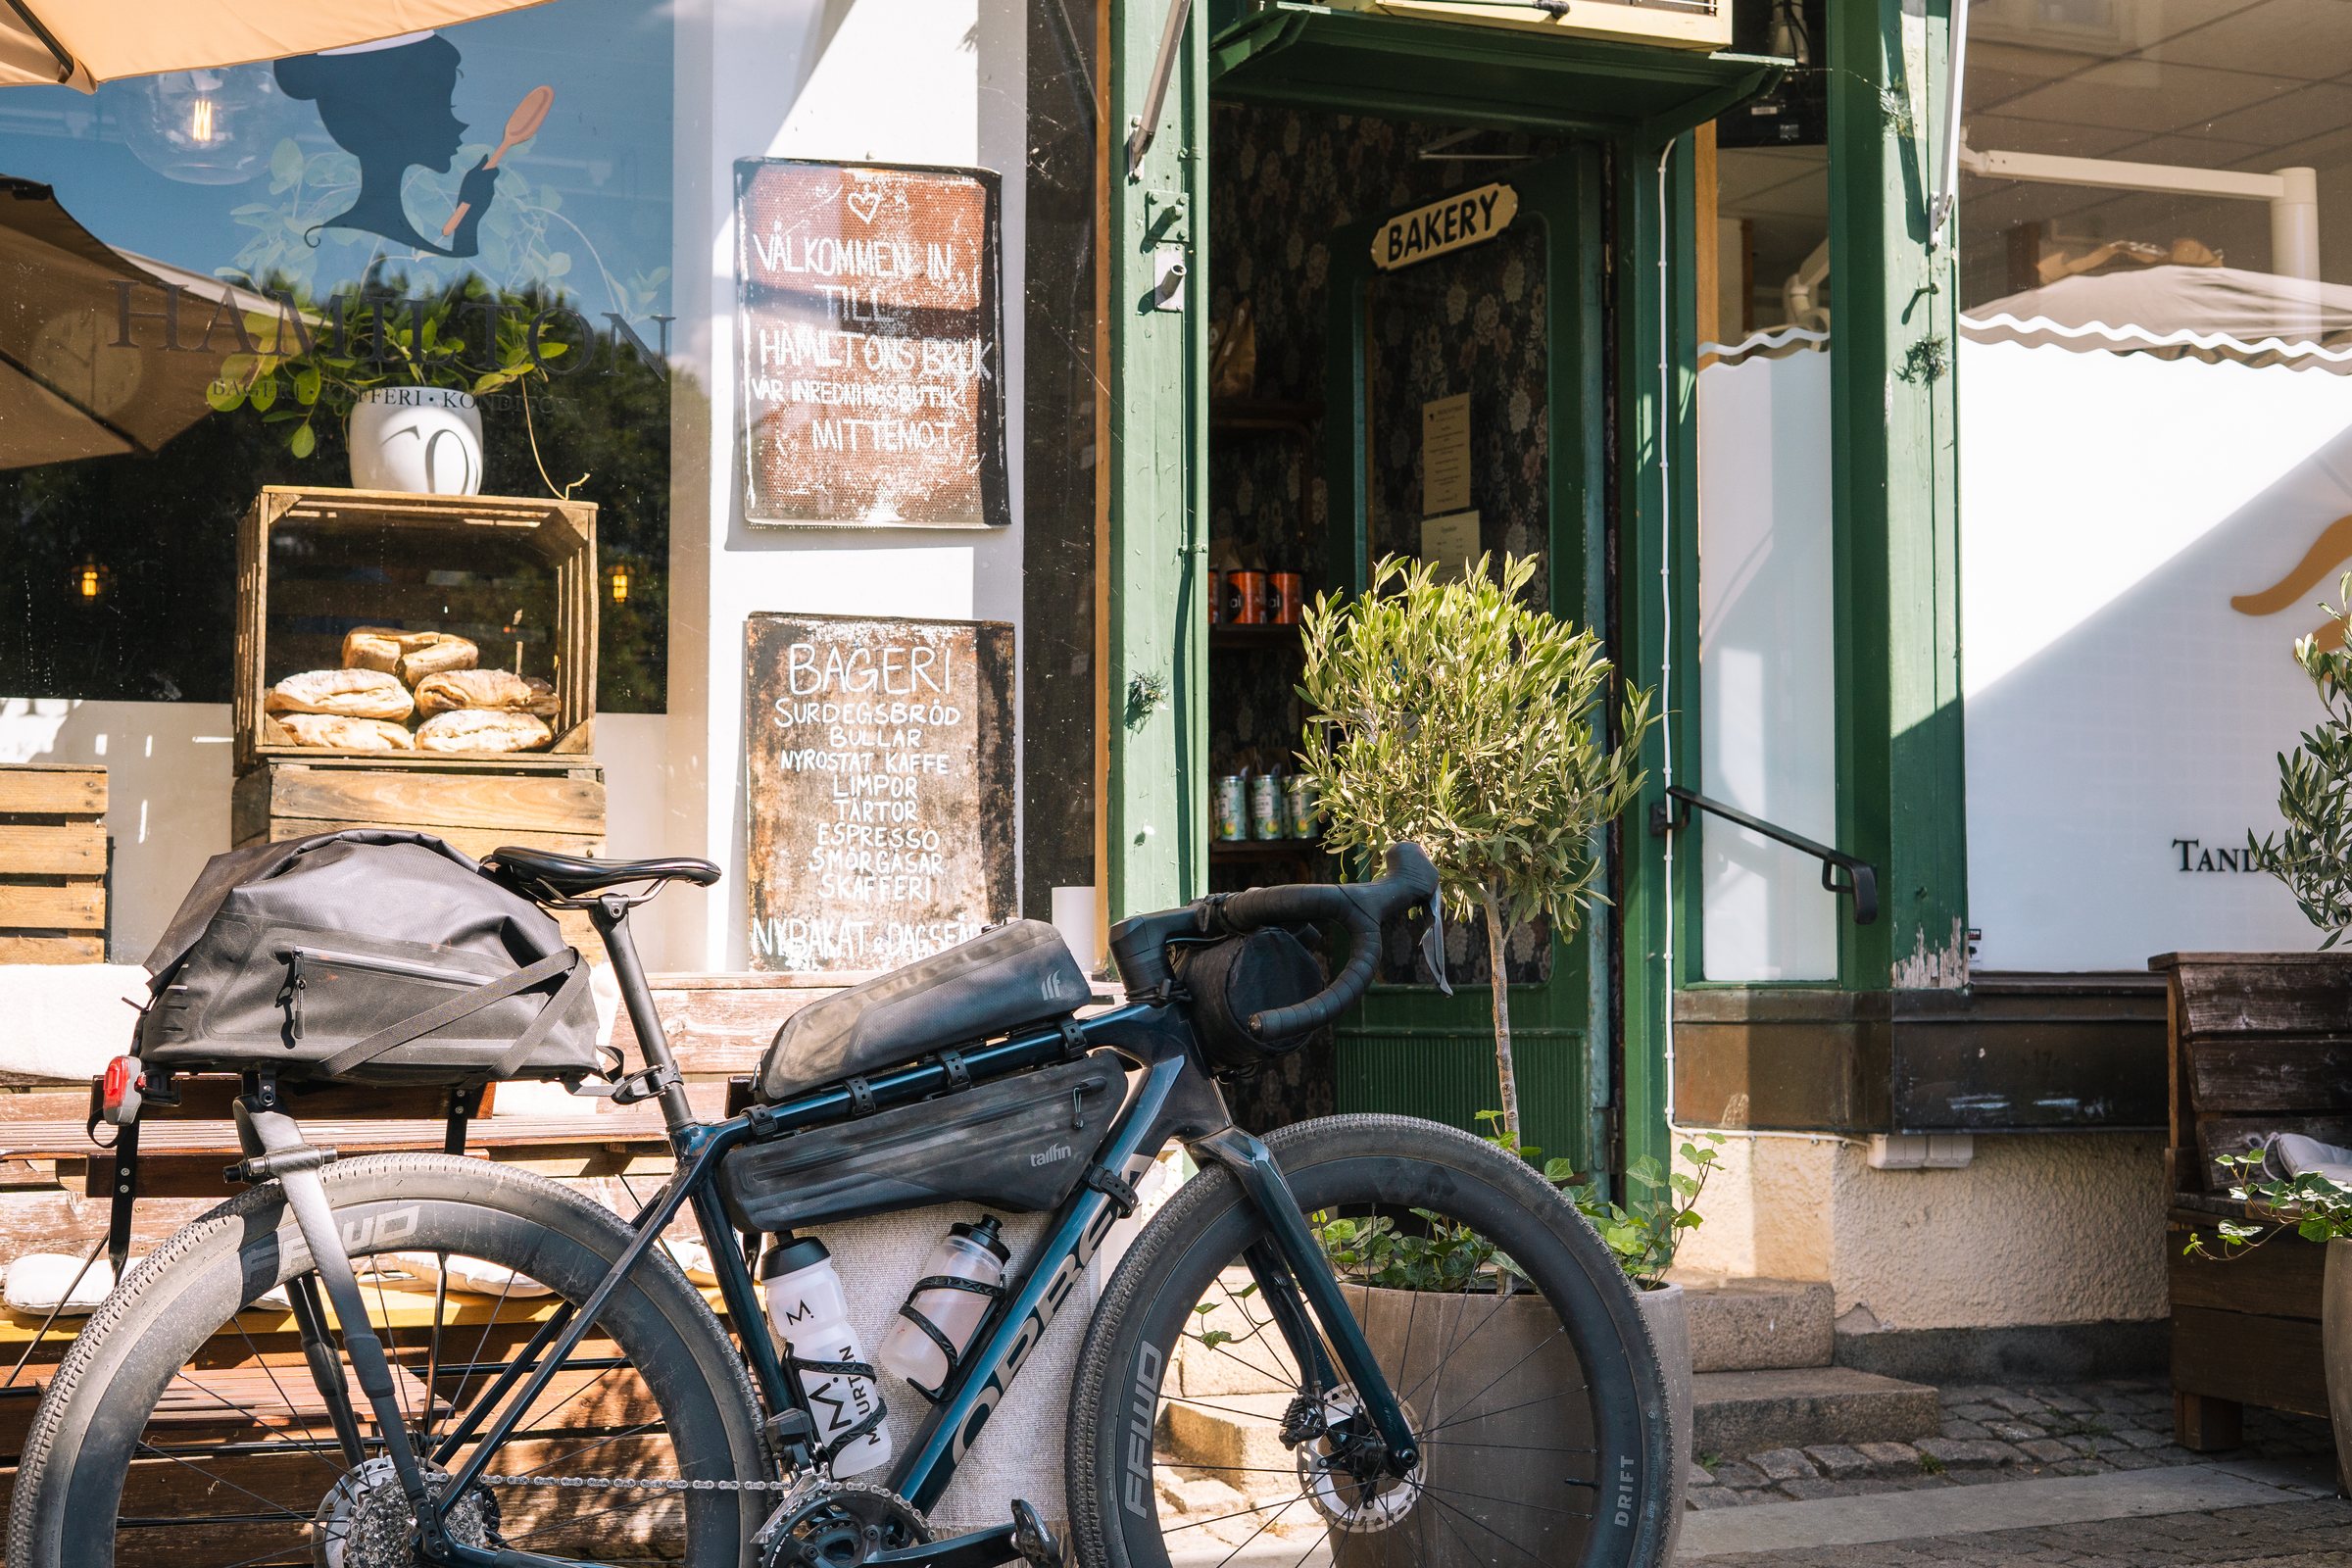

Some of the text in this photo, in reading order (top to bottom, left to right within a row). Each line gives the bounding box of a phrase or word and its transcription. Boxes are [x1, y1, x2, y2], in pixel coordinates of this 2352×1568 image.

[1388, 190, 1499, 263] BAKERY
[927, 242, 953, 279] IN
[814, 285, 894, 322] TILL
[108, 279, 676, 382] HAMILTON
[811, 418, 956, 452] MITTEMOT
[789, 643, 951, 696] BAGERI
[774, 697, 961, 728] SURDEGSBRÖD
[830, 727, 921, 749] BULLAR
[781, 749, 950, 774] NYROSTAT KAFFE
[833, 775, 918, 799] LIMPOR
[817, 822, 941, 852] ESPRESSO
[808, 847, 945, 875] SMÖRGÅSAR
[817, 873, 931, 903] SKAFFERI
[752, 917, 873, 958] NYBAKAT
[1030, 1143, 1072, 1167] tailfin
[839, 1346, 881, 1446] MURTN
[1125, 1340, 1162, 1519] FFWD
[1614, 1455, 1635, 1527] DRIFT
